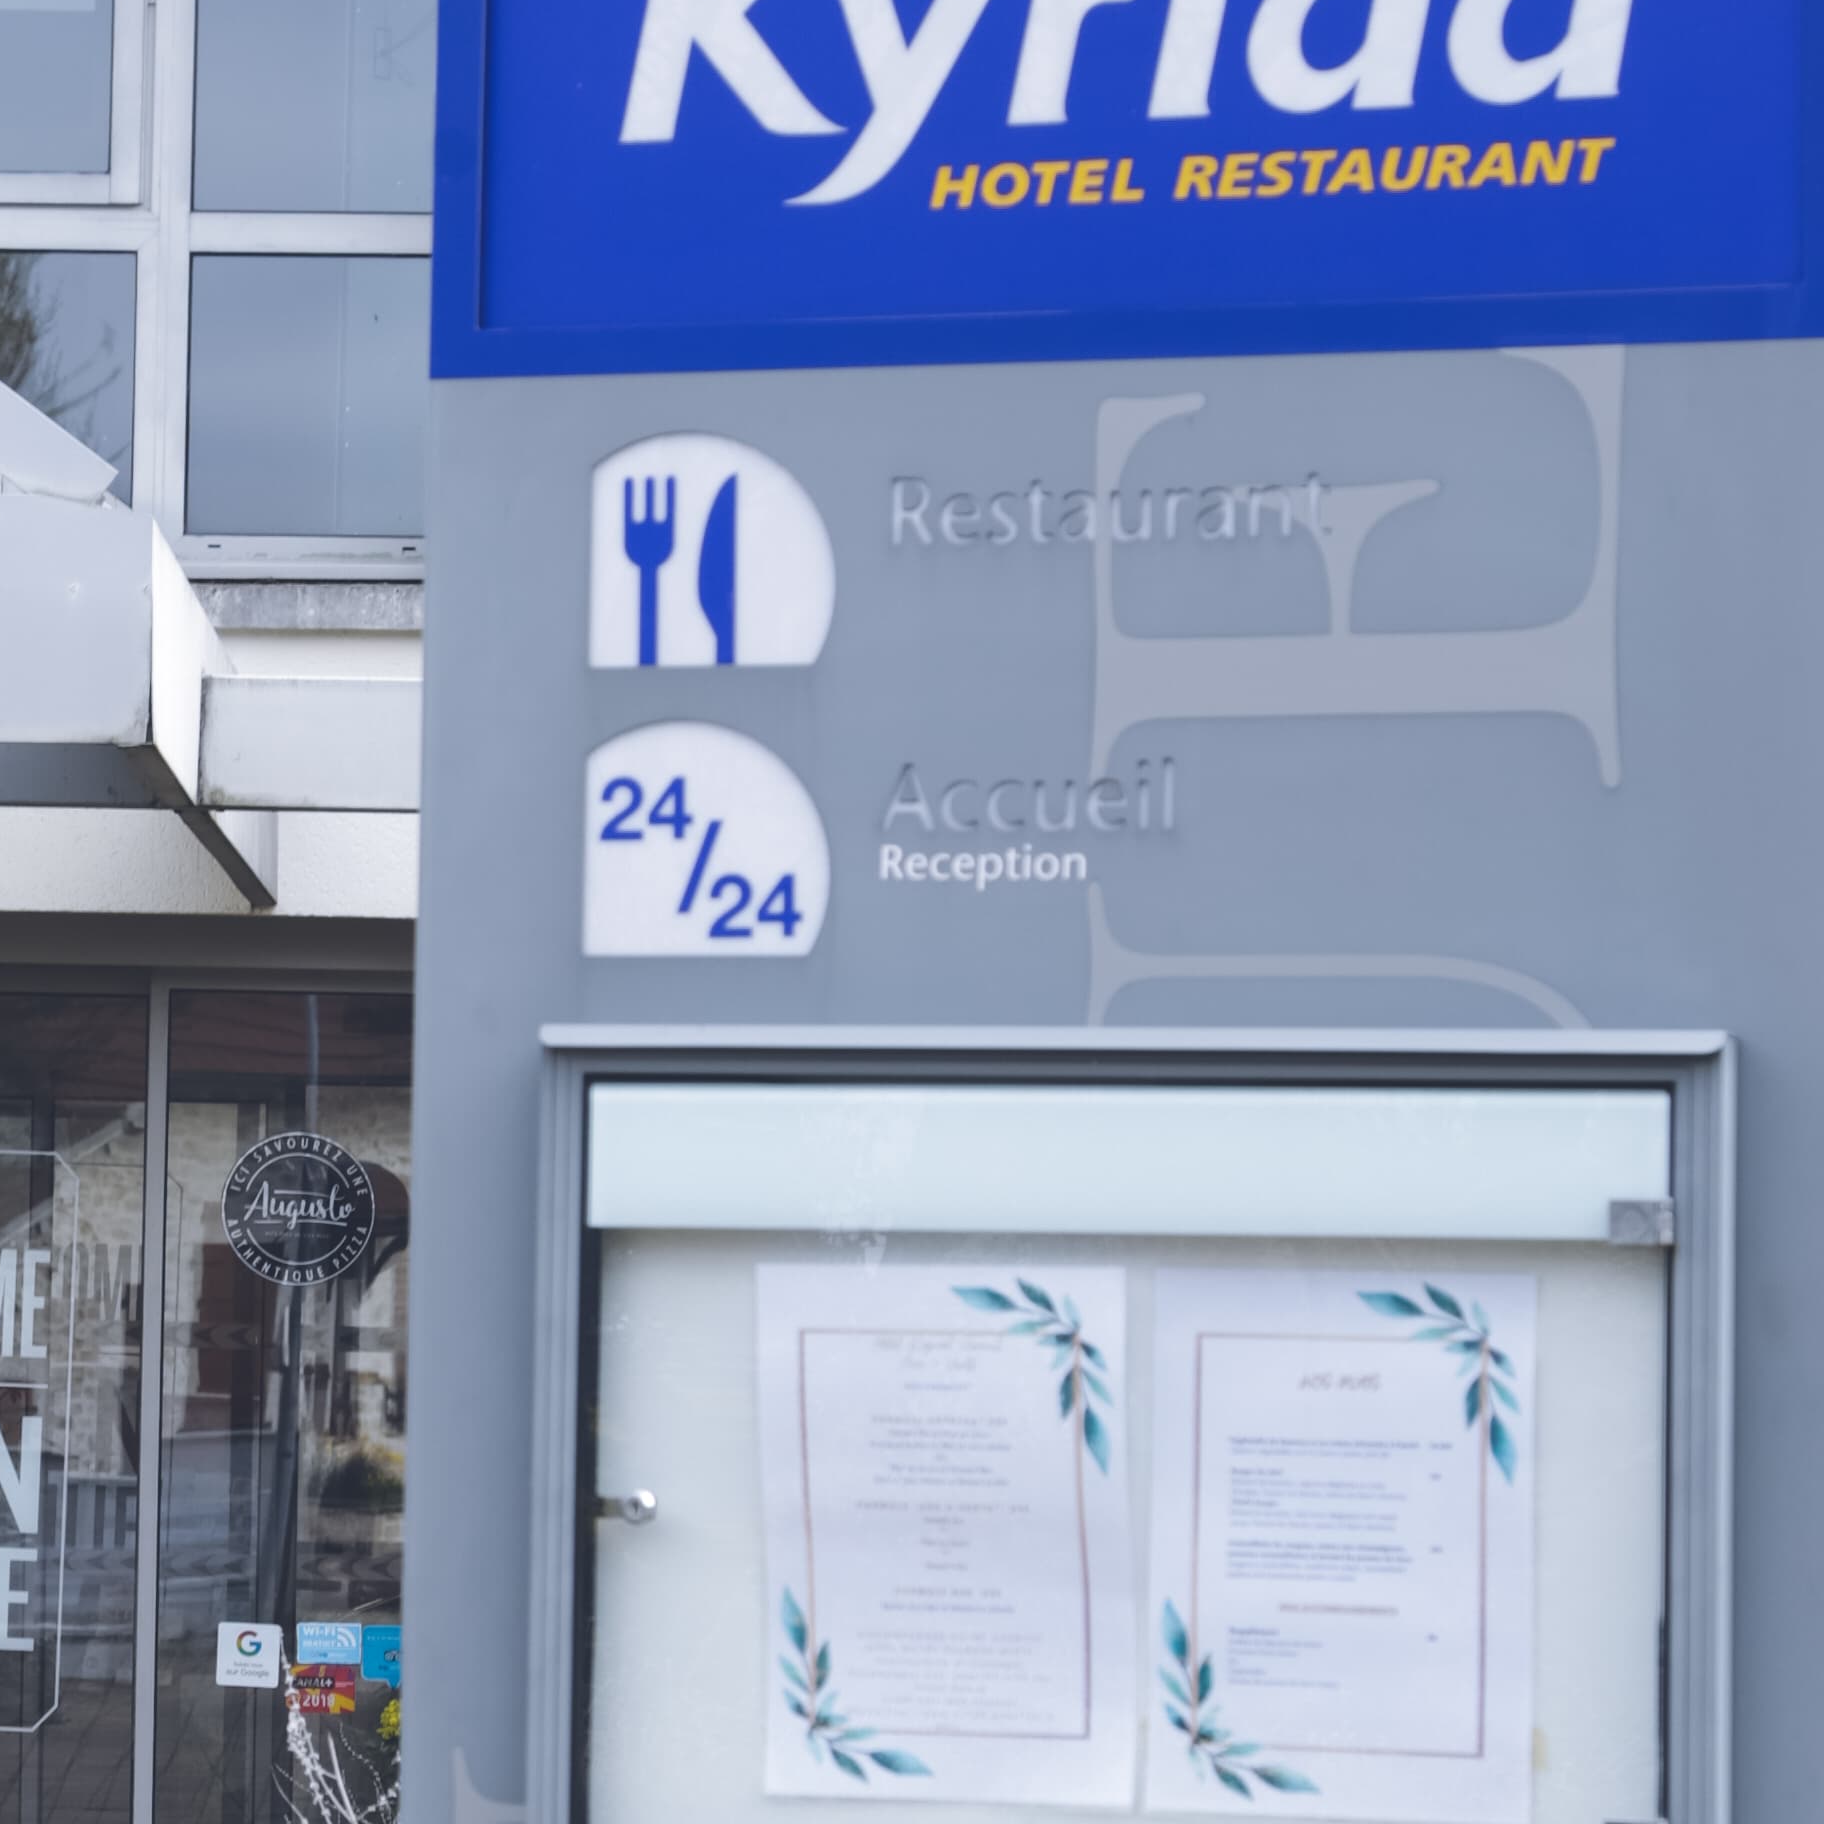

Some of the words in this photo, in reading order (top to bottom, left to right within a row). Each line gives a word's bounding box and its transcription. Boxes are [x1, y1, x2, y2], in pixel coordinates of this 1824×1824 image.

[928, 159, 1144, 209] HOTEL
[1173, 137, 1616, 201] RESTAURANT
[890, 472, 1333, 546] Restaurant
[881, 756, 1178, 833] Accueil
[879, 844, 1088, 890] Reception
[230, 1165, 250, 1192] ICI
[253, 1137, 343, 1163] SAVOUREZ
[346, 1165, 369, 1197] UNE
[243, 1180, 356, 1230] Augusto
[227, 1219, 326, 1283] AUTHENTIQUE
[332, 1226, 368, 1270] PIZZA
